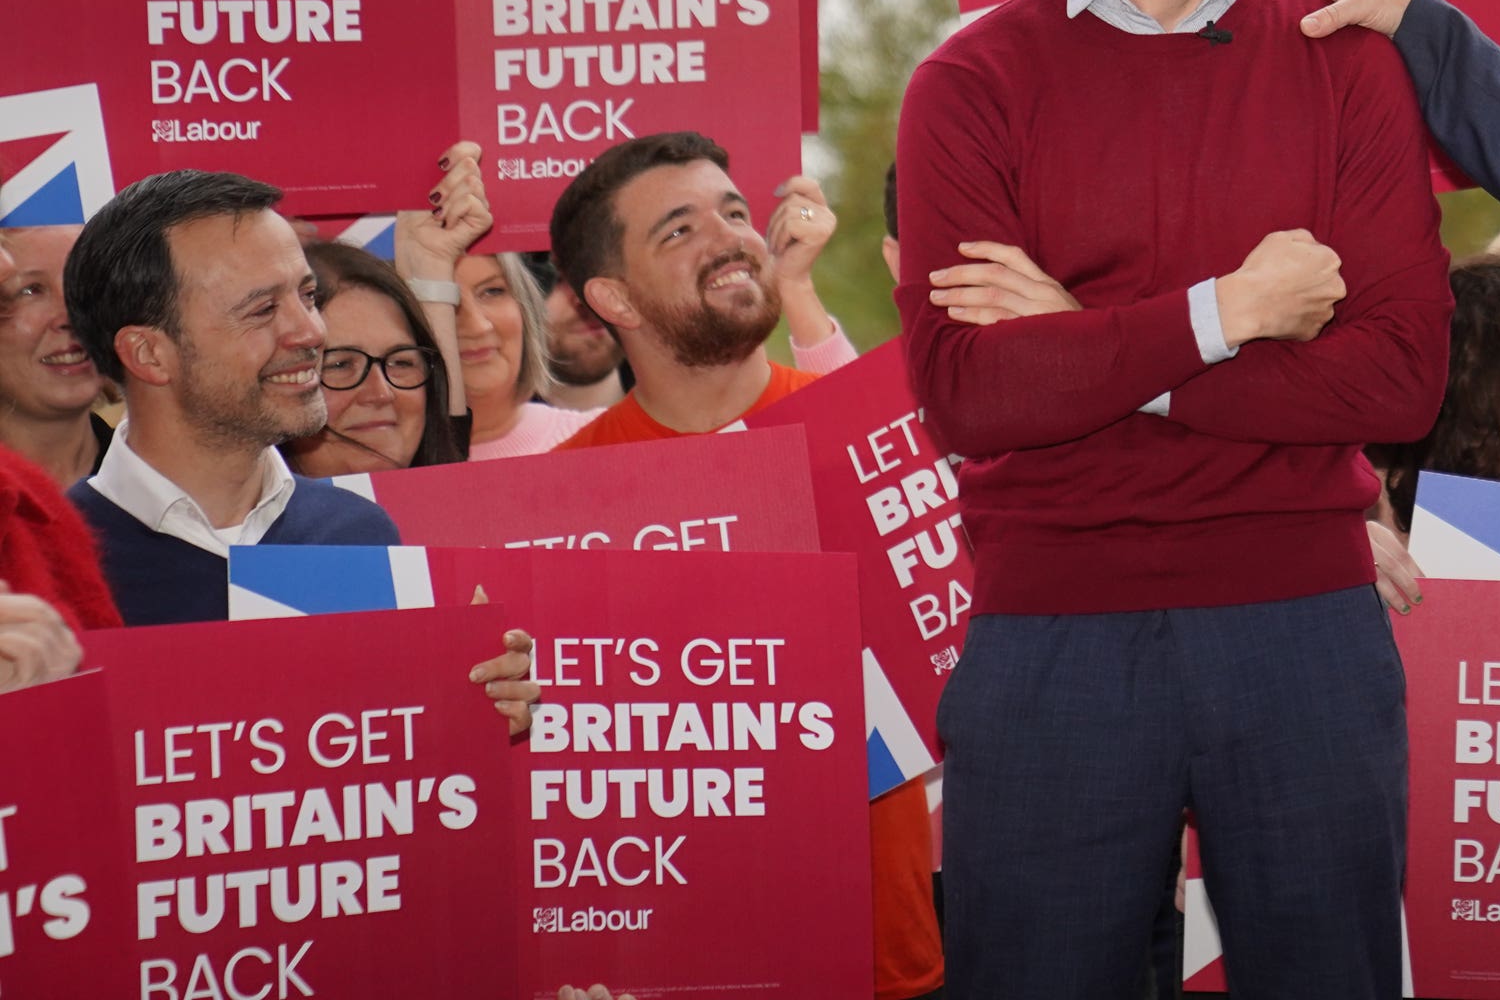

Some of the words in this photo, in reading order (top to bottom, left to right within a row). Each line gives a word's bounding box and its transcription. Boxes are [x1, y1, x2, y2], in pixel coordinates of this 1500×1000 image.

[150, 58, 292, 104] BACK
[494, 41, 706, 91] FUTURE
[175, 120, 261, 142] Labour
[497, 98, 636, 145] BACK
[847, 407, 924, 484] LET'
[533, 638, 660, 686] LET'S
[680, 638, 785, 686] GET
[135, 719, 286, 786] LET'S
[308, 706, 425, 768] GET
[529, 701, 834, 752] BRITAIN'S
[530, 767, 765, 819] FUTURE
[136, 775, 478, 863] BRITAIN'S
[533, 836, 687, 888] BACK
[137, 855, 401, 940] FUTURE
[558, 906, 653, 932] Labour
[140, 940, 315, 1000] BACK
